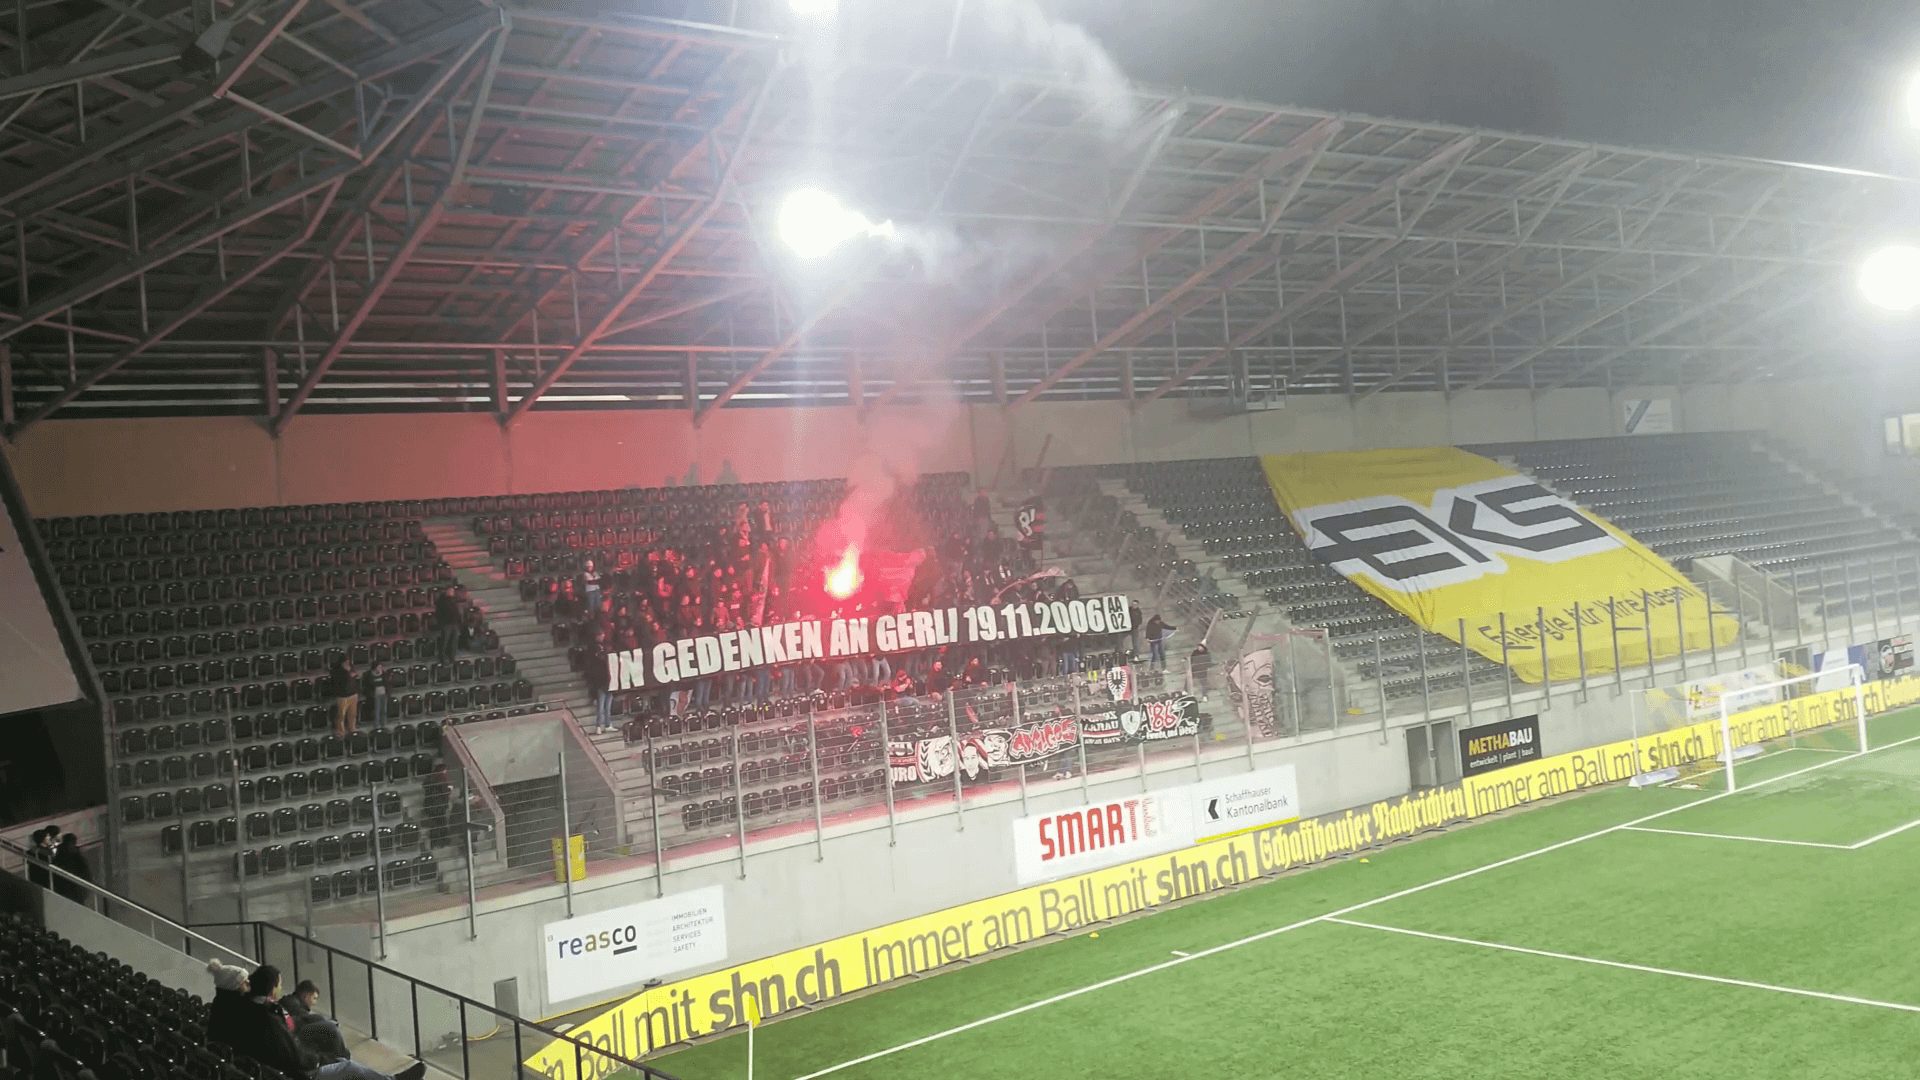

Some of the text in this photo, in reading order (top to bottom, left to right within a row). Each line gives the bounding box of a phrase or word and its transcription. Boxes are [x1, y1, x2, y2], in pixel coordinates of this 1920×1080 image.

[1108, 597, 1123, 613] AA
[1110, 612, 1128, 630] 02
[608, 599, 1106, 692] IN GEDENKEN AN GERLI 19.11.2006
[1468, 727, 1533, 756] METHABAU
[1469, 755, 1498, 768] entwickelt
[1502, 751, 1517, 763] plant
[1470, 727, 1704, 817] Immer am Ball mit shn.ch
[1225, 786, 1273, 804] Schaffhauser
[1226, 795, 1289, 819] Kantonalbank
[671, 907, 708, 921] IMMOBILIEN
[862, 842, 1250, 986] Immer am Ball mit shn.ch
[672, 916, 714, 932] ARCHITEKTUR
[558, 925, 637, 959] reasco
[672, 930, 702, 943] SERVICES
[673, 942, 697, 954] SAFETY
[634, 987, 700, 1058] mit
[709, 947, 842, 1032] shn.ch
